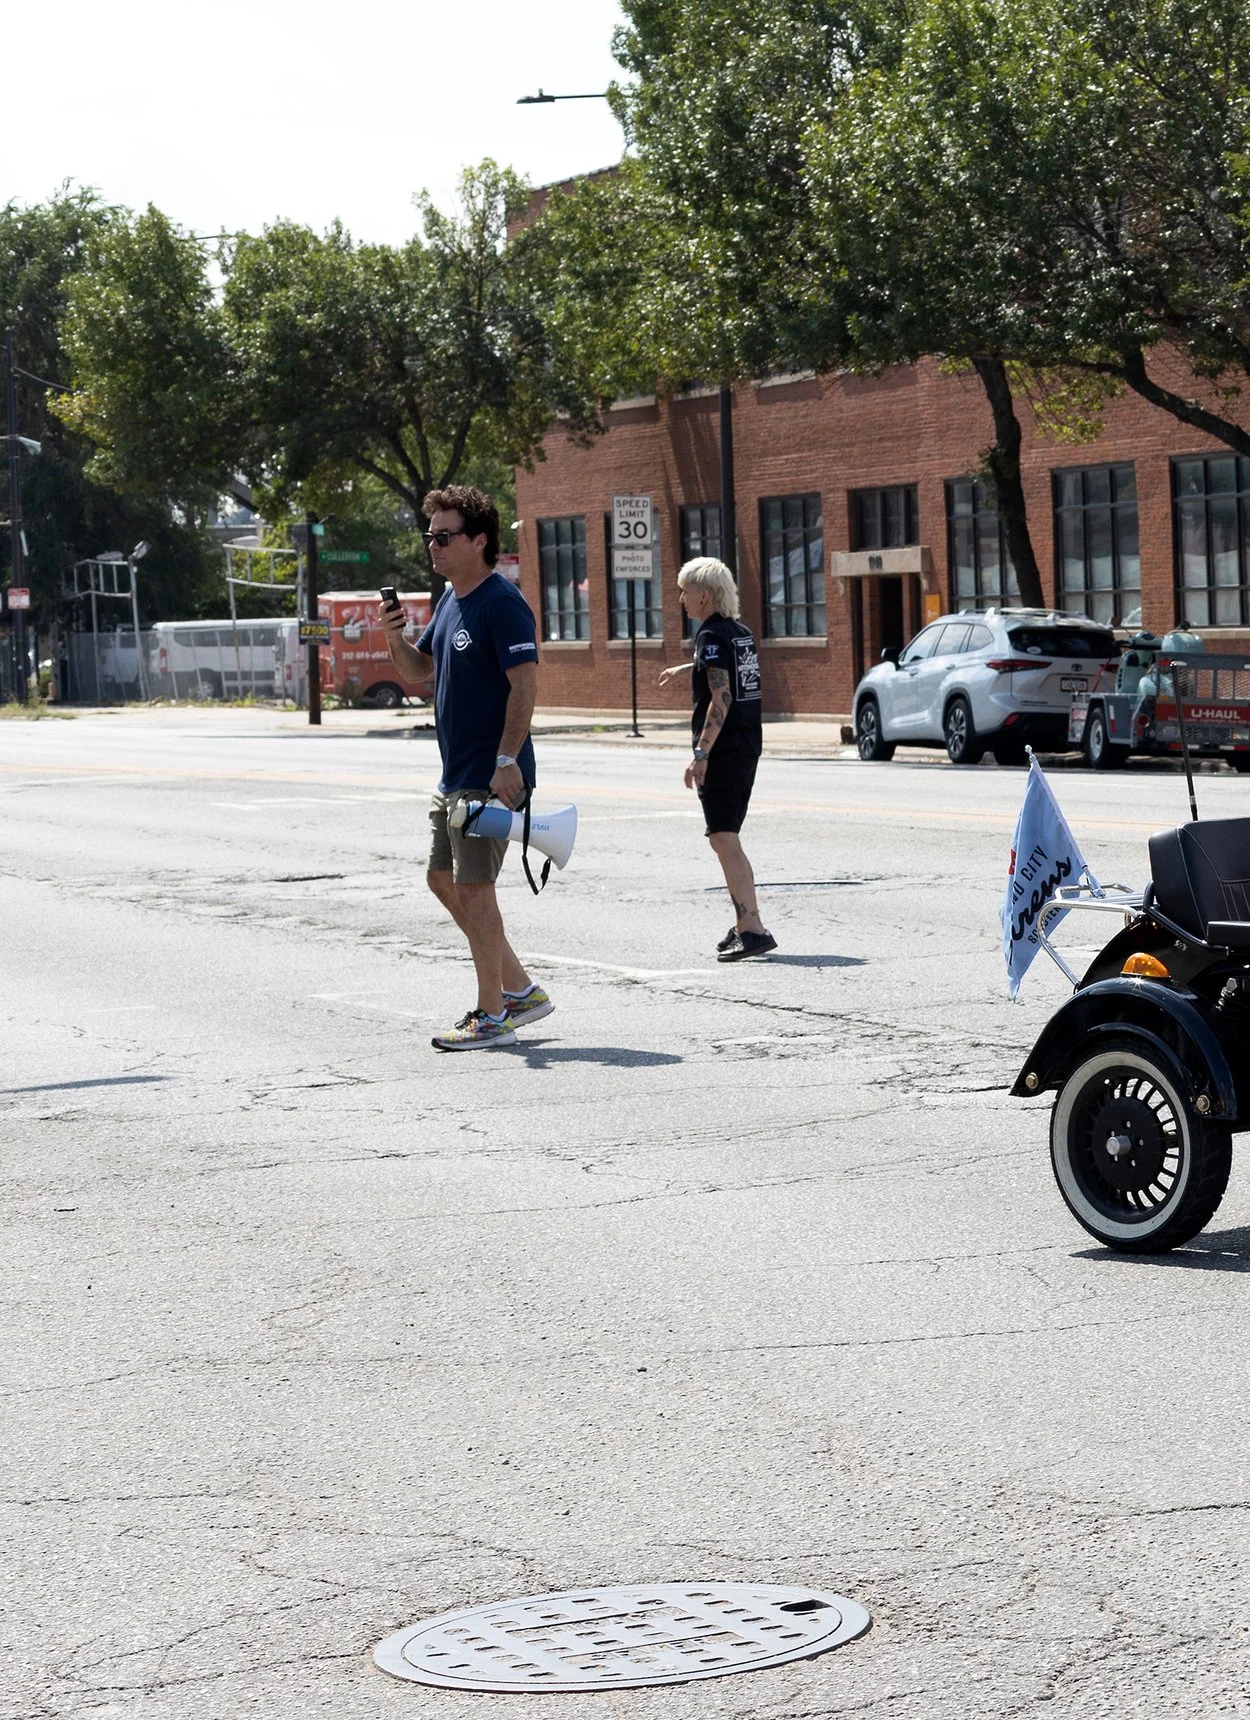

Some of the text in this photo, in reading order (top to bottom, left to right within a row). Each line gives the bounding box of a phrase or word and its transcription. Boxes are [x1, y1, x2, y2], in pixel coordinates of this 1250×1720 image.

[616, 499, 649, 508] SPEED
[619, 509, 646, 518] LIMIT
[618, 520, 648, 539] 30
[615, 565, 650, 573] ENFORCED
[1191, 708, 1241, 719] U-HAUL
[1020, 845, 1048, 882] CITY
[1011, 856, 1072, 942] irens
